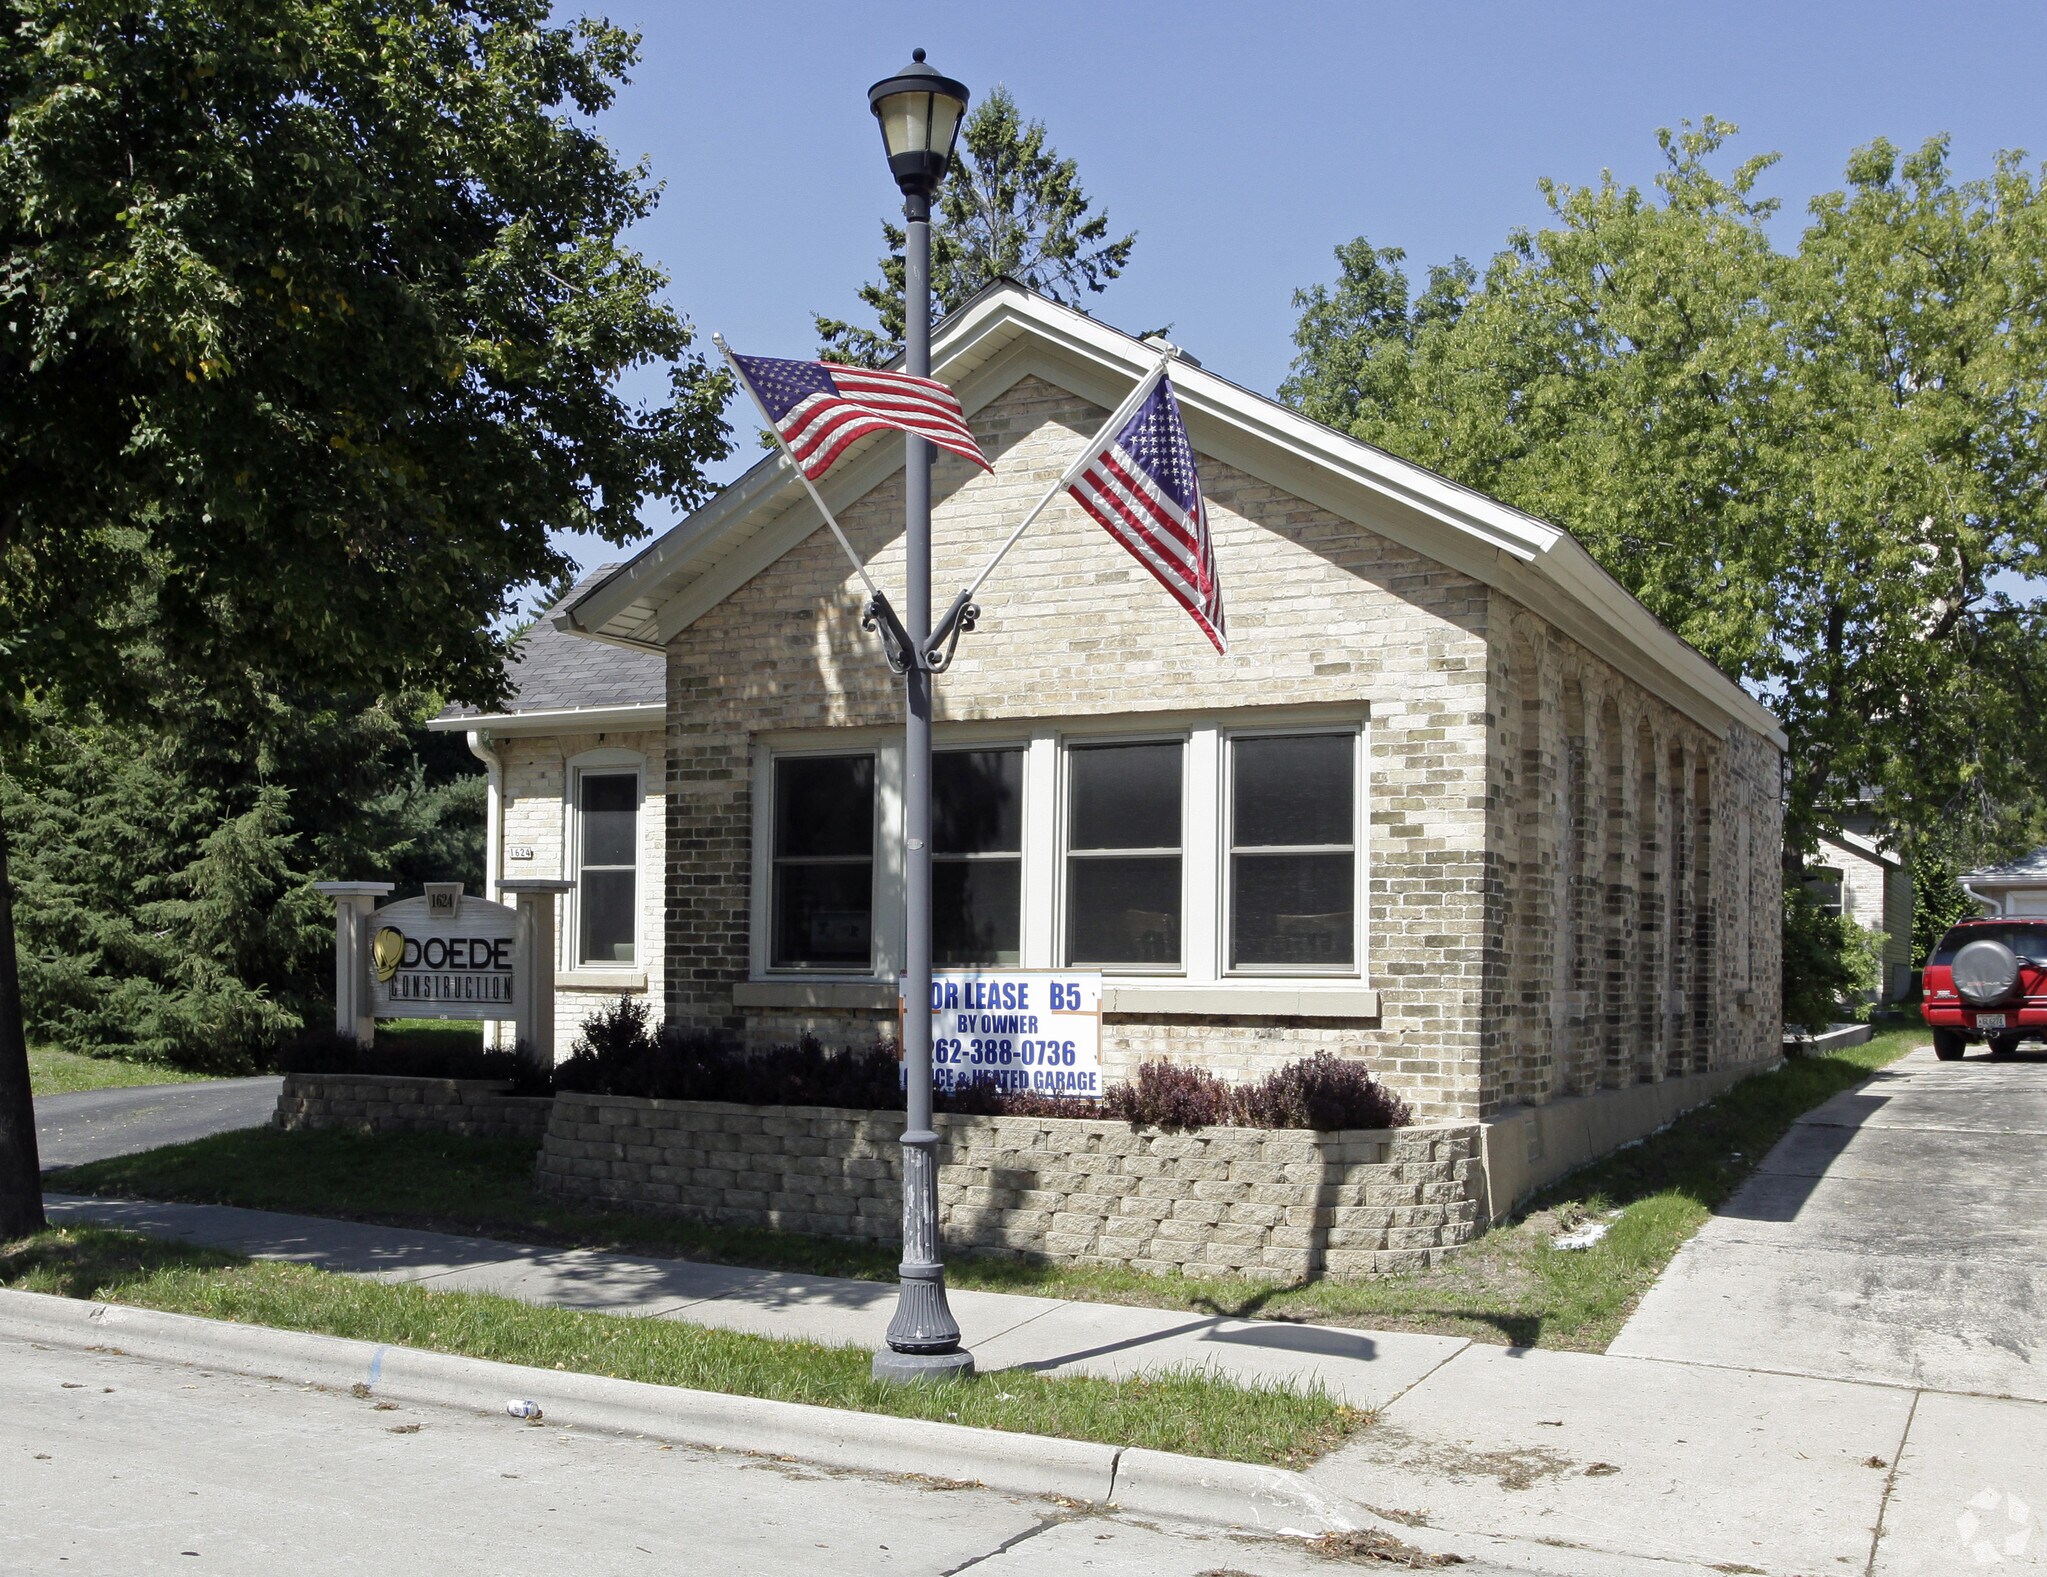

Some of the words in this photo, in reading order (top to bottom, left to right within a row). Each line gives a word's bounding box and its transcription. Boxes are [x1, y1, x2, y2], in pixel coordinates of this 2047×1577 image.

[510, 848, 530, 857] 1624
[431, 893, 452, 908] 1624
[400, 937, 513, 969] DOEDE
[391, 975, 511, 999] CONSTRUCTION
[931, 982, 958, 1009] OR
[964, 982, 1029, 1009] LEASE
[1050, 982, 1081, 1011] B5
[957, 1015, 977, 1033] BY
[981, 1015, 1038, 1034] OWNER
[931, 1038, 1076, 1066] 62-388-0736
[1034, 1071, 1097, 1091] GARAGE
